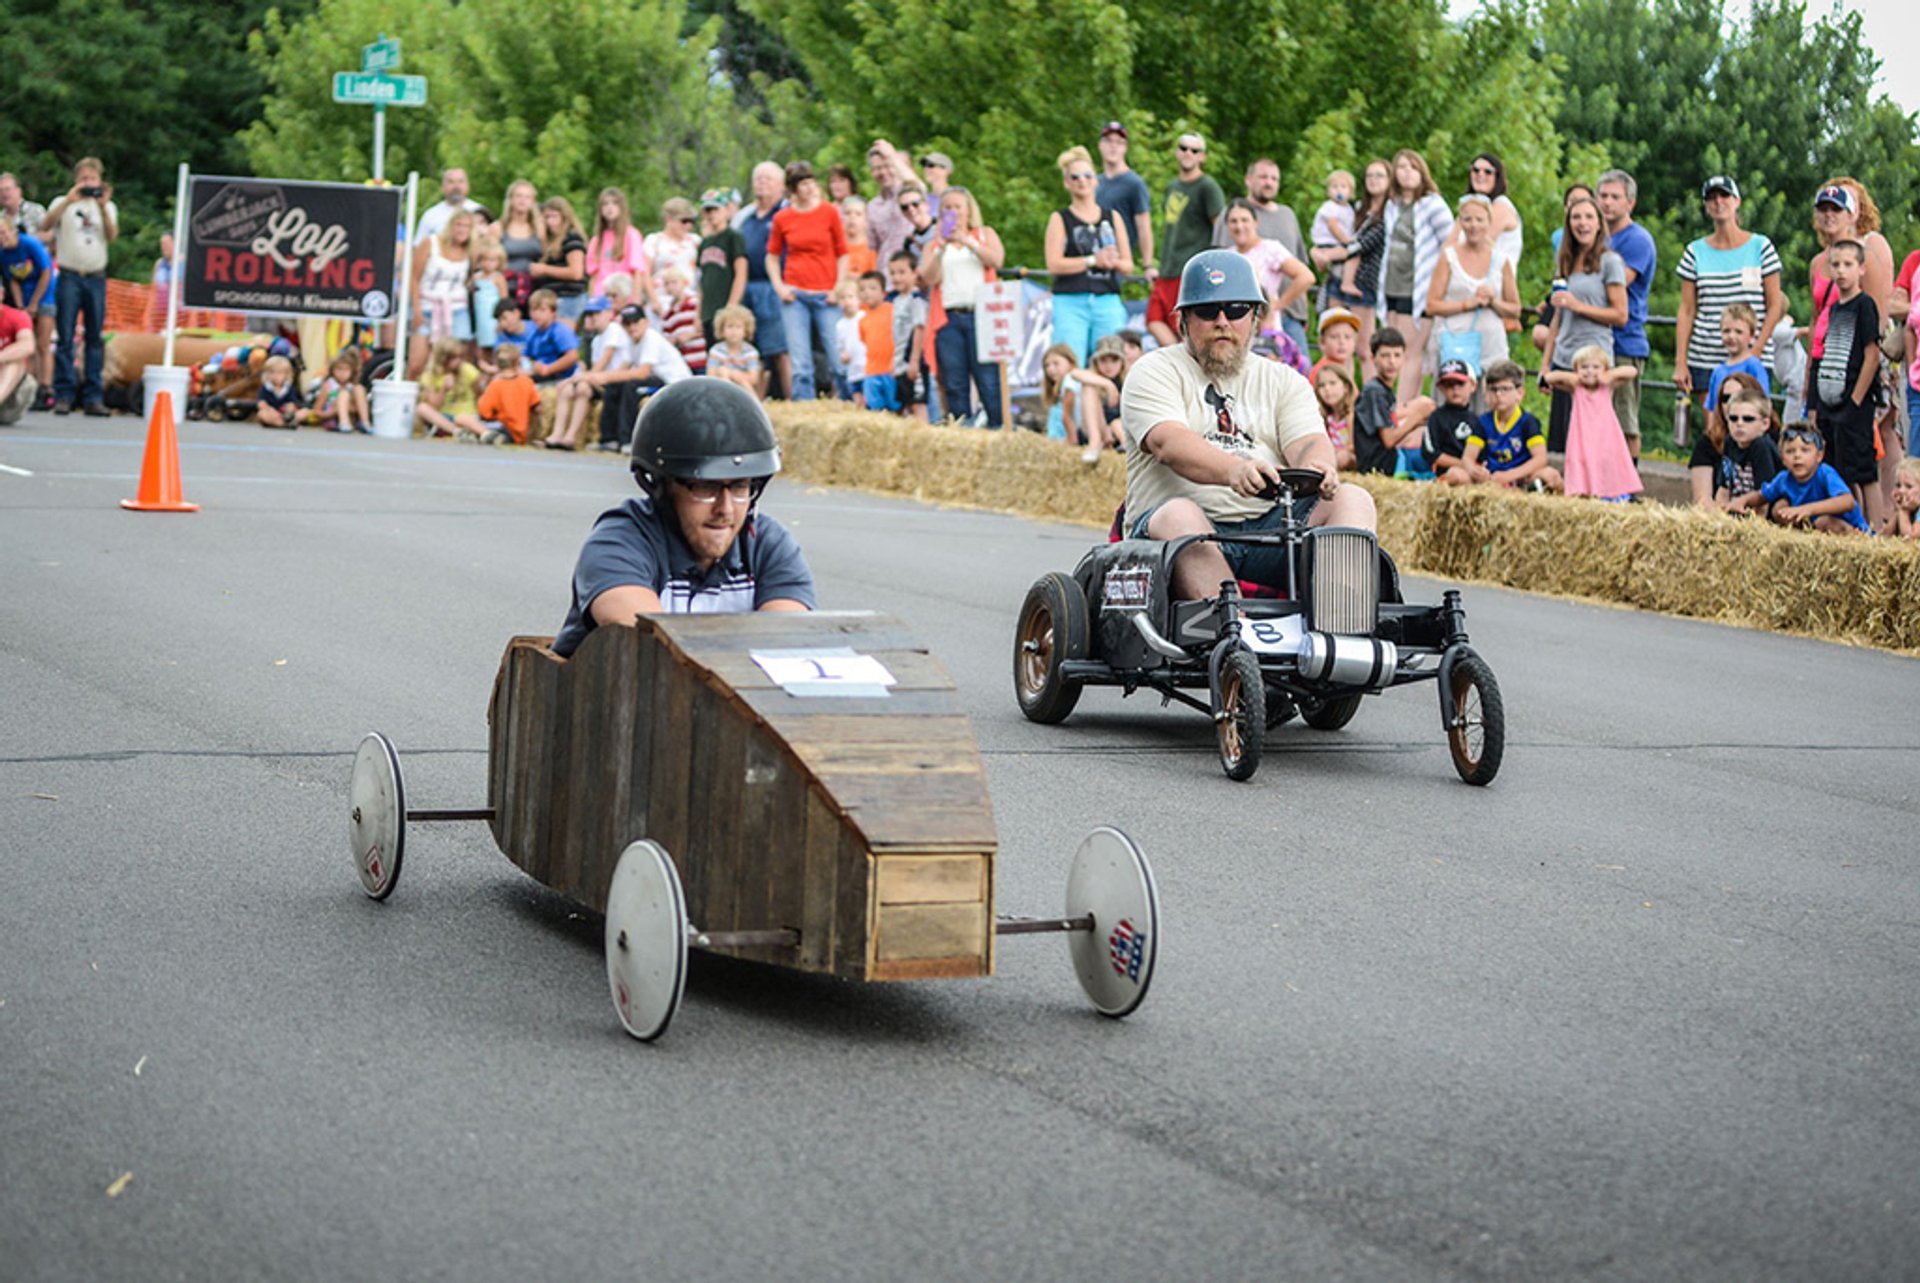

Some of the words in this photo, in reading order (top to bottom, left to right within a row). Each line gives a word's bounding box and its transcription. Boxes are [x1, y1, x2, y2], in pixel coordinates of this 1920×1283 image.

[345, 78, 396, 99] Linden
[251, 207, 349, 272] Log
[204, 246, 376, 291] ROLLING
[1251, 622, 1283, 644] 8
[801, 657, 844, 680] 1
